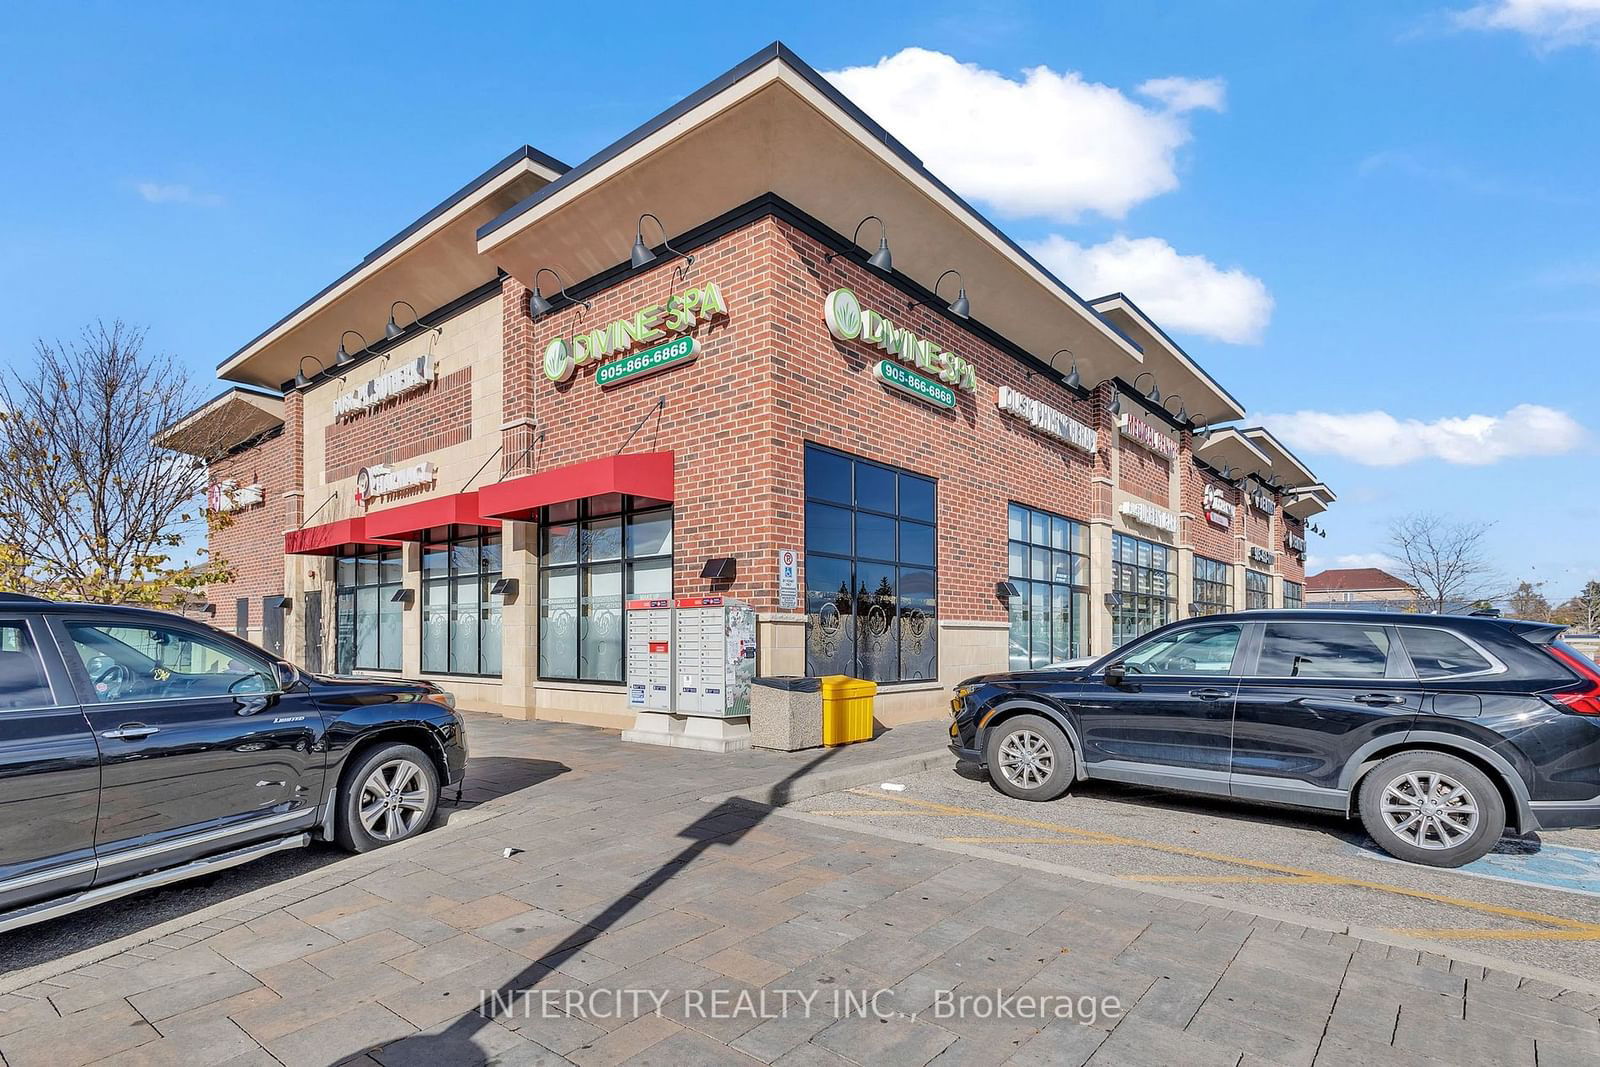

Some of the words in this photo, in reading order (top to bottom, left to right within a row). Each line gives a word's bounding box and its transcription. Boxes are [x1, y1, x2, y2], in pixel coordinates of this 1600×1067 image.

[573, 304, 664, 365] DIVINE
[665, 281, 727, 334] SPA
[600, 341, 688, 381] 905-866-6868
[861, 310, 943, 374] DIVINE
[938, 352, 977, 393] SPA
[885, 364, 952, 404] 905-866-6868
[999, 386, 1034, 421] DUSK
